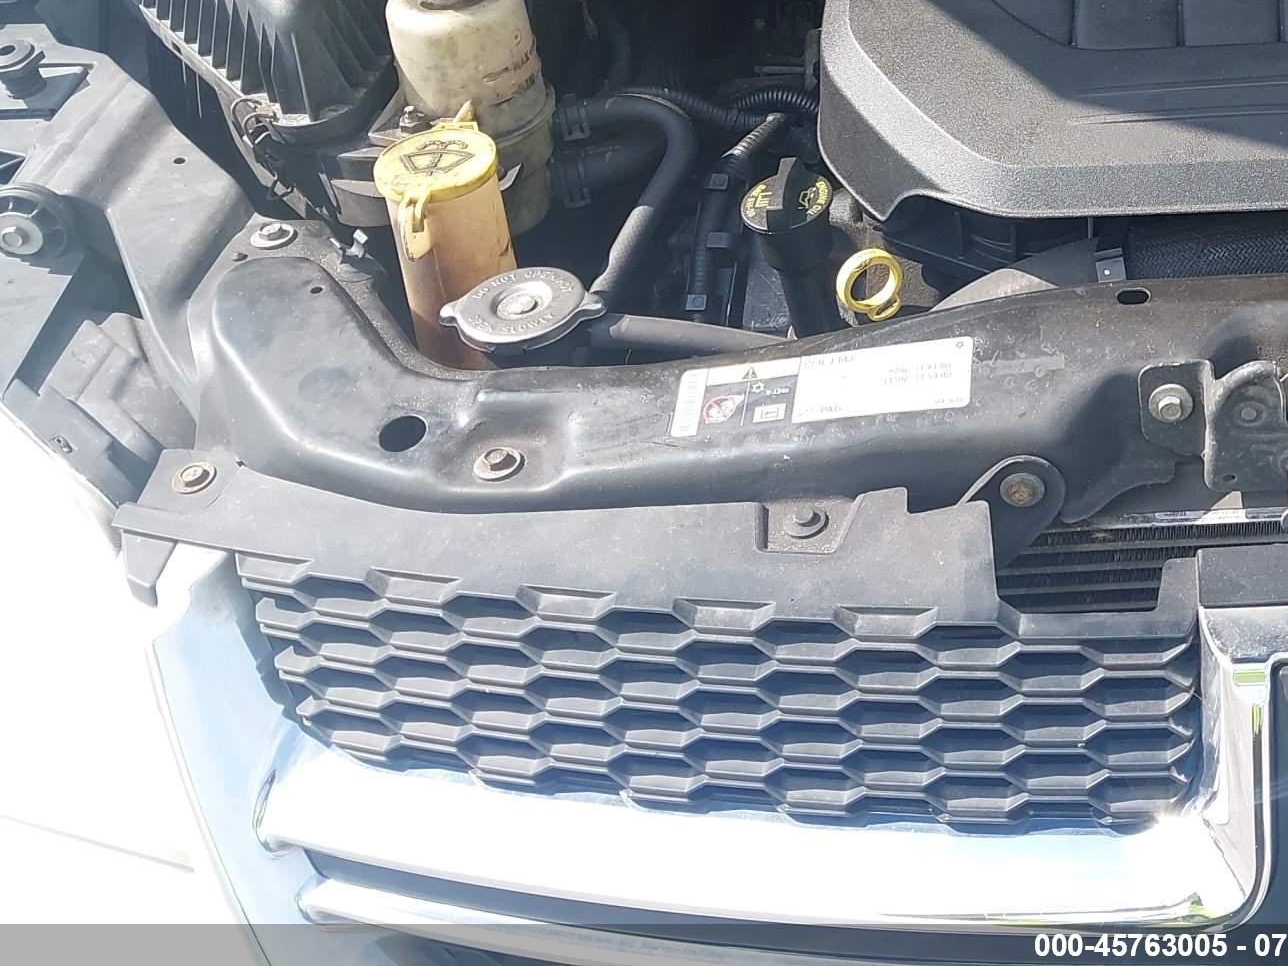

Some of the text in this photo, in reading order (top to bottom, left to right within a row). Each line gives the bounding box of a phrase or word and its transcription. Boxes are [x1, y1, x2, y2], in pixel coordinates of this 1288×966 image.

[806, 180, 829, 215] ENGINE OIL
[502, 312, 554, 333] SLOWLY
